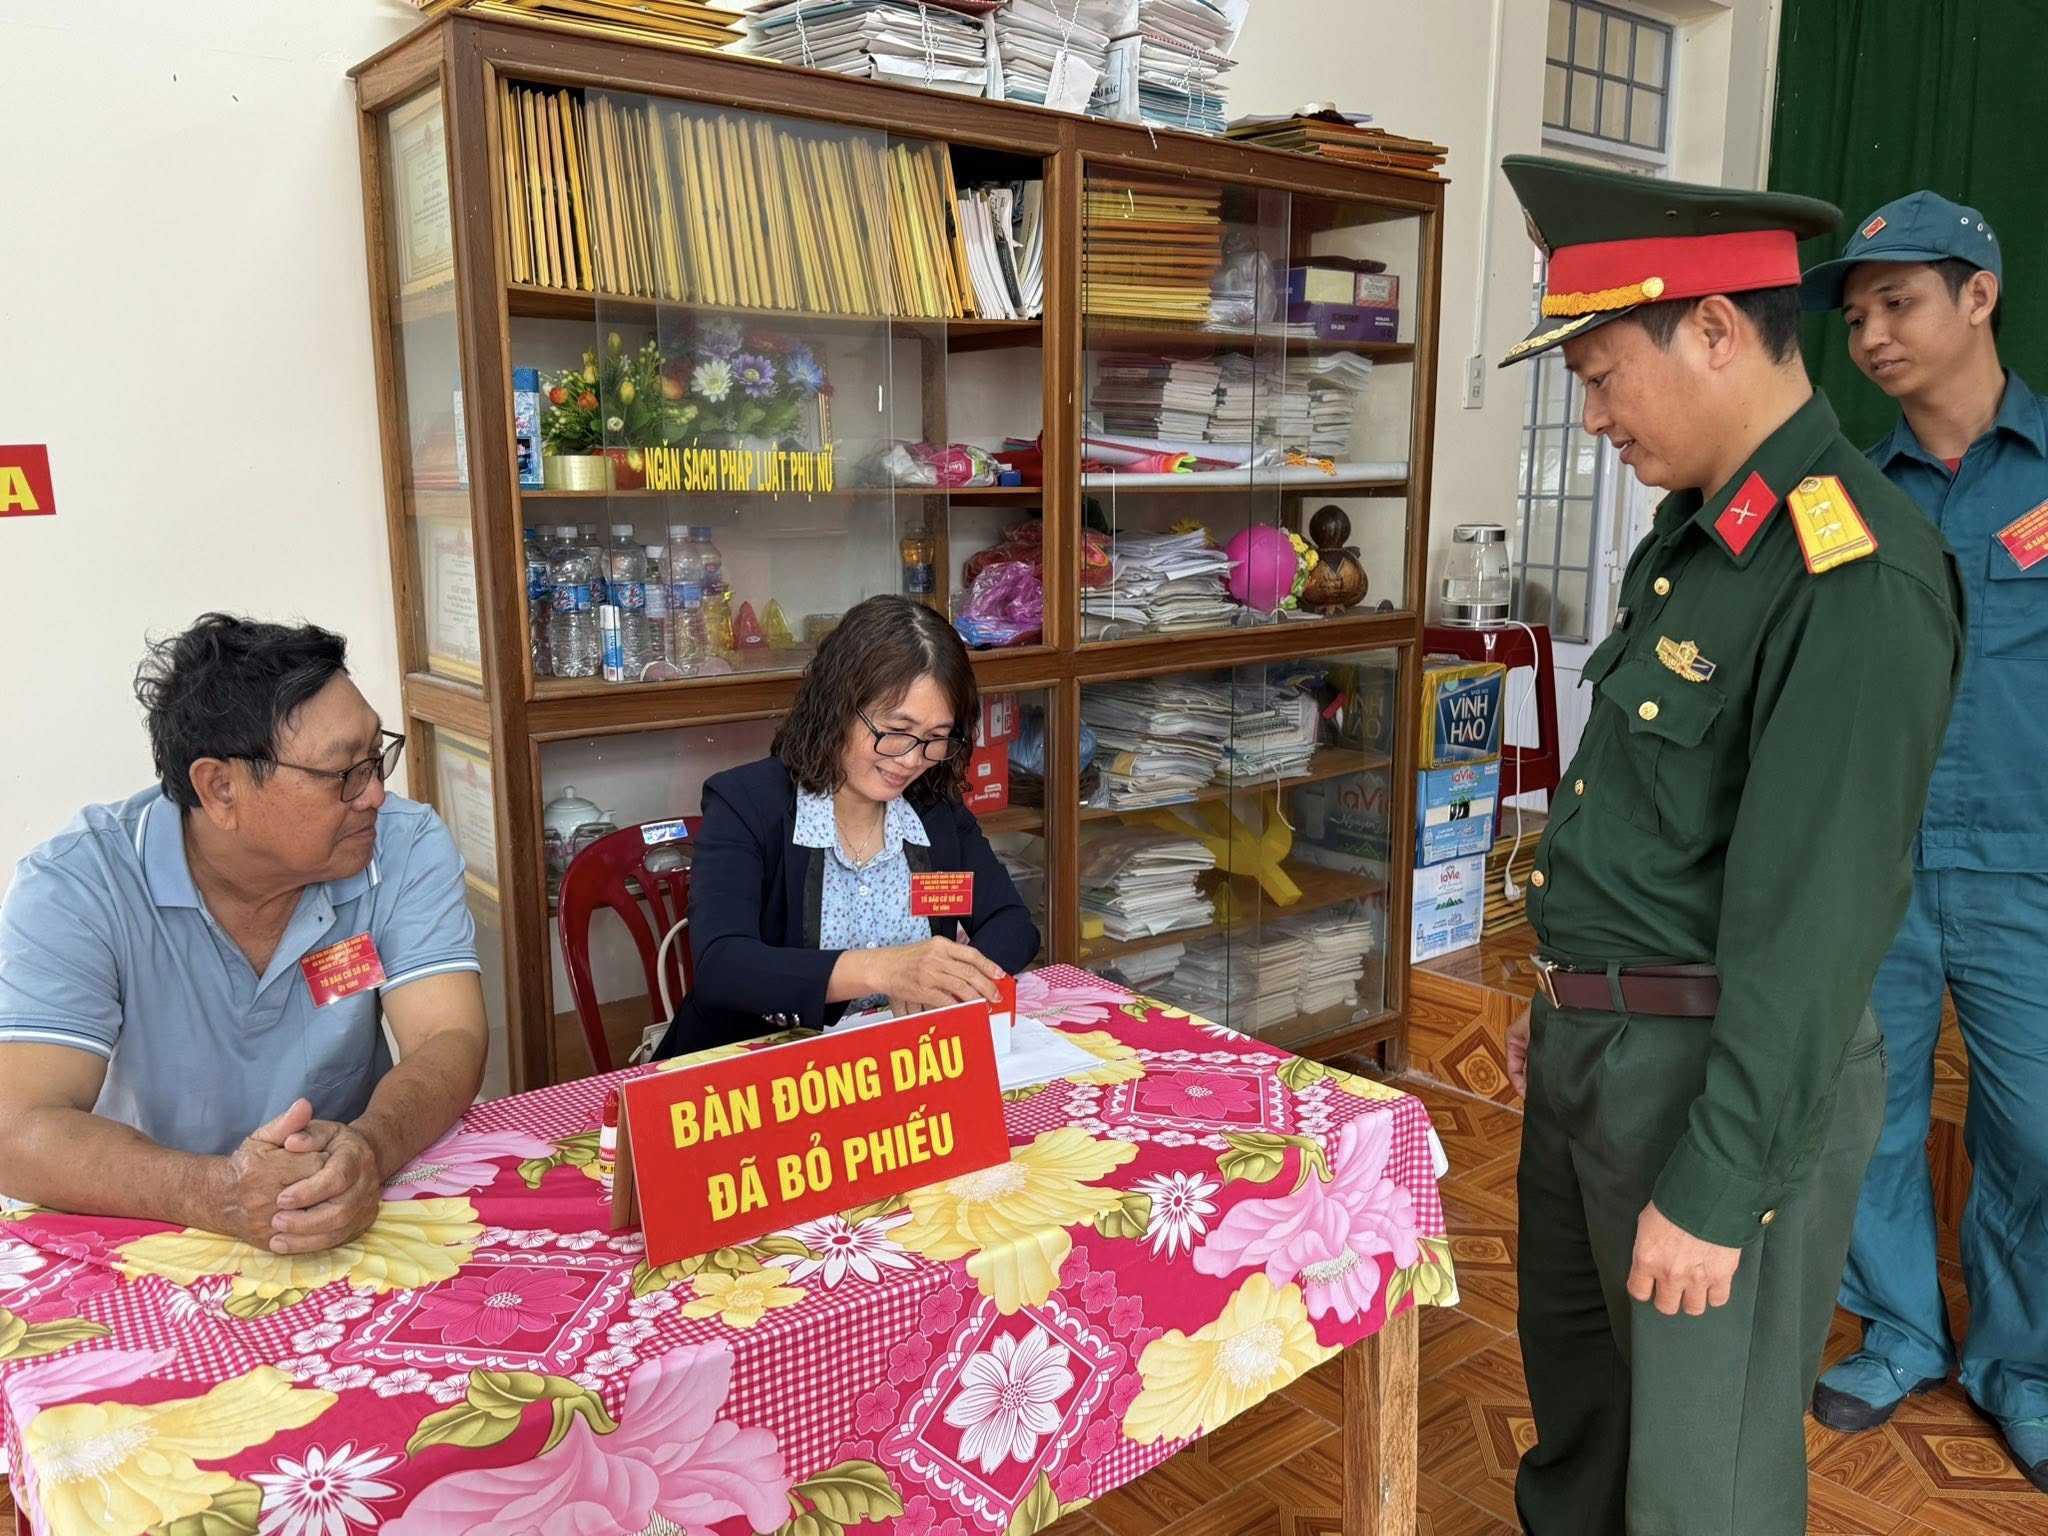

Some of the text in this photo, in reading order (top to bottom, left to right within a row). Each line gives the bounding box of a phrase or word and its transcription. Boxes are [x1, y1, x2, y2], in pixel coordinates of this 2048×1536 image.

[644, 437, 833, 502] NGĂN SÁCH PHÁP LUẬT PHỤ NỮ
[1449, 693, 1488, 720] VĨNH
[669, 1025, 965, 1149] BÀN ĐÓNG DẤU
[707, 1104, 955, 1222] ĐÃ BỎ PHIẾU
